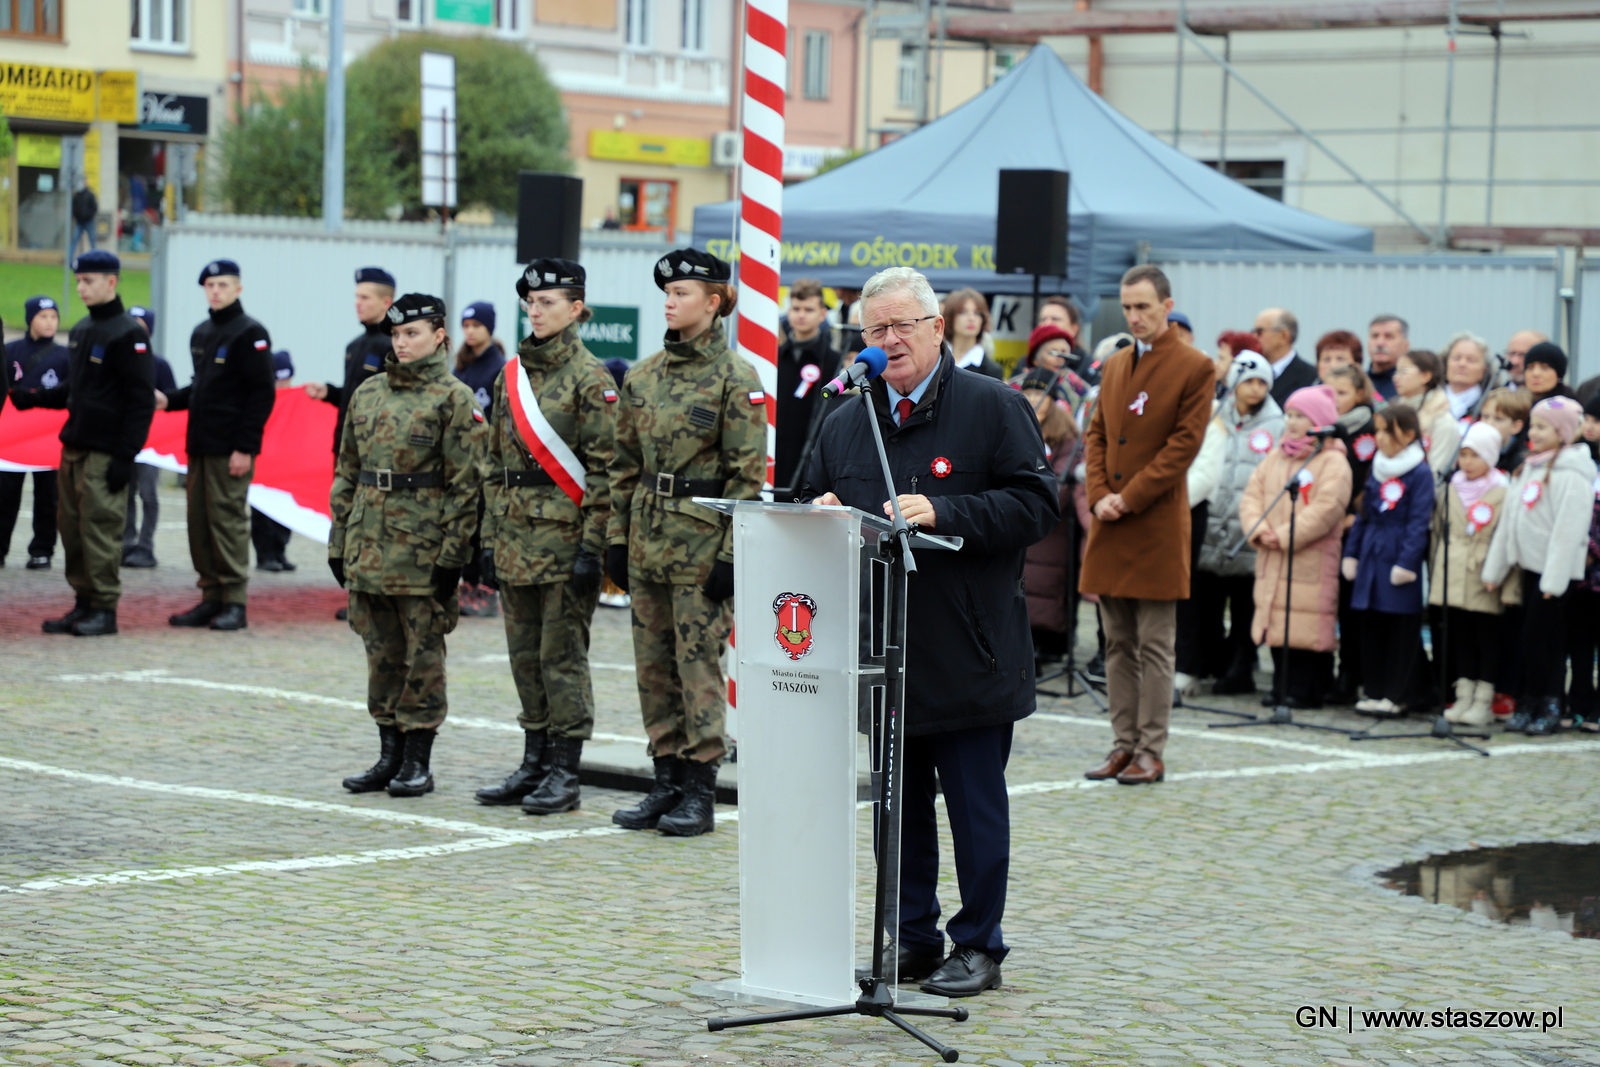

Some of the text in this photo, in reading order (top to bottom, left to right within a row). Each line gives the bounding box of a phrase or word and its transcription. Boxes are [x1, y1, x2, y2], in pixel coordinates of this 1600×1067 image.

[706, 240, 840, 266] STAWSKI
[850, 235, 959, 269] OŚRODEK
[772, 669, 793, 677] Miasto
[798, 671, 819, 680] Gmina
[772, 680, 819, 694] STASZÓW
